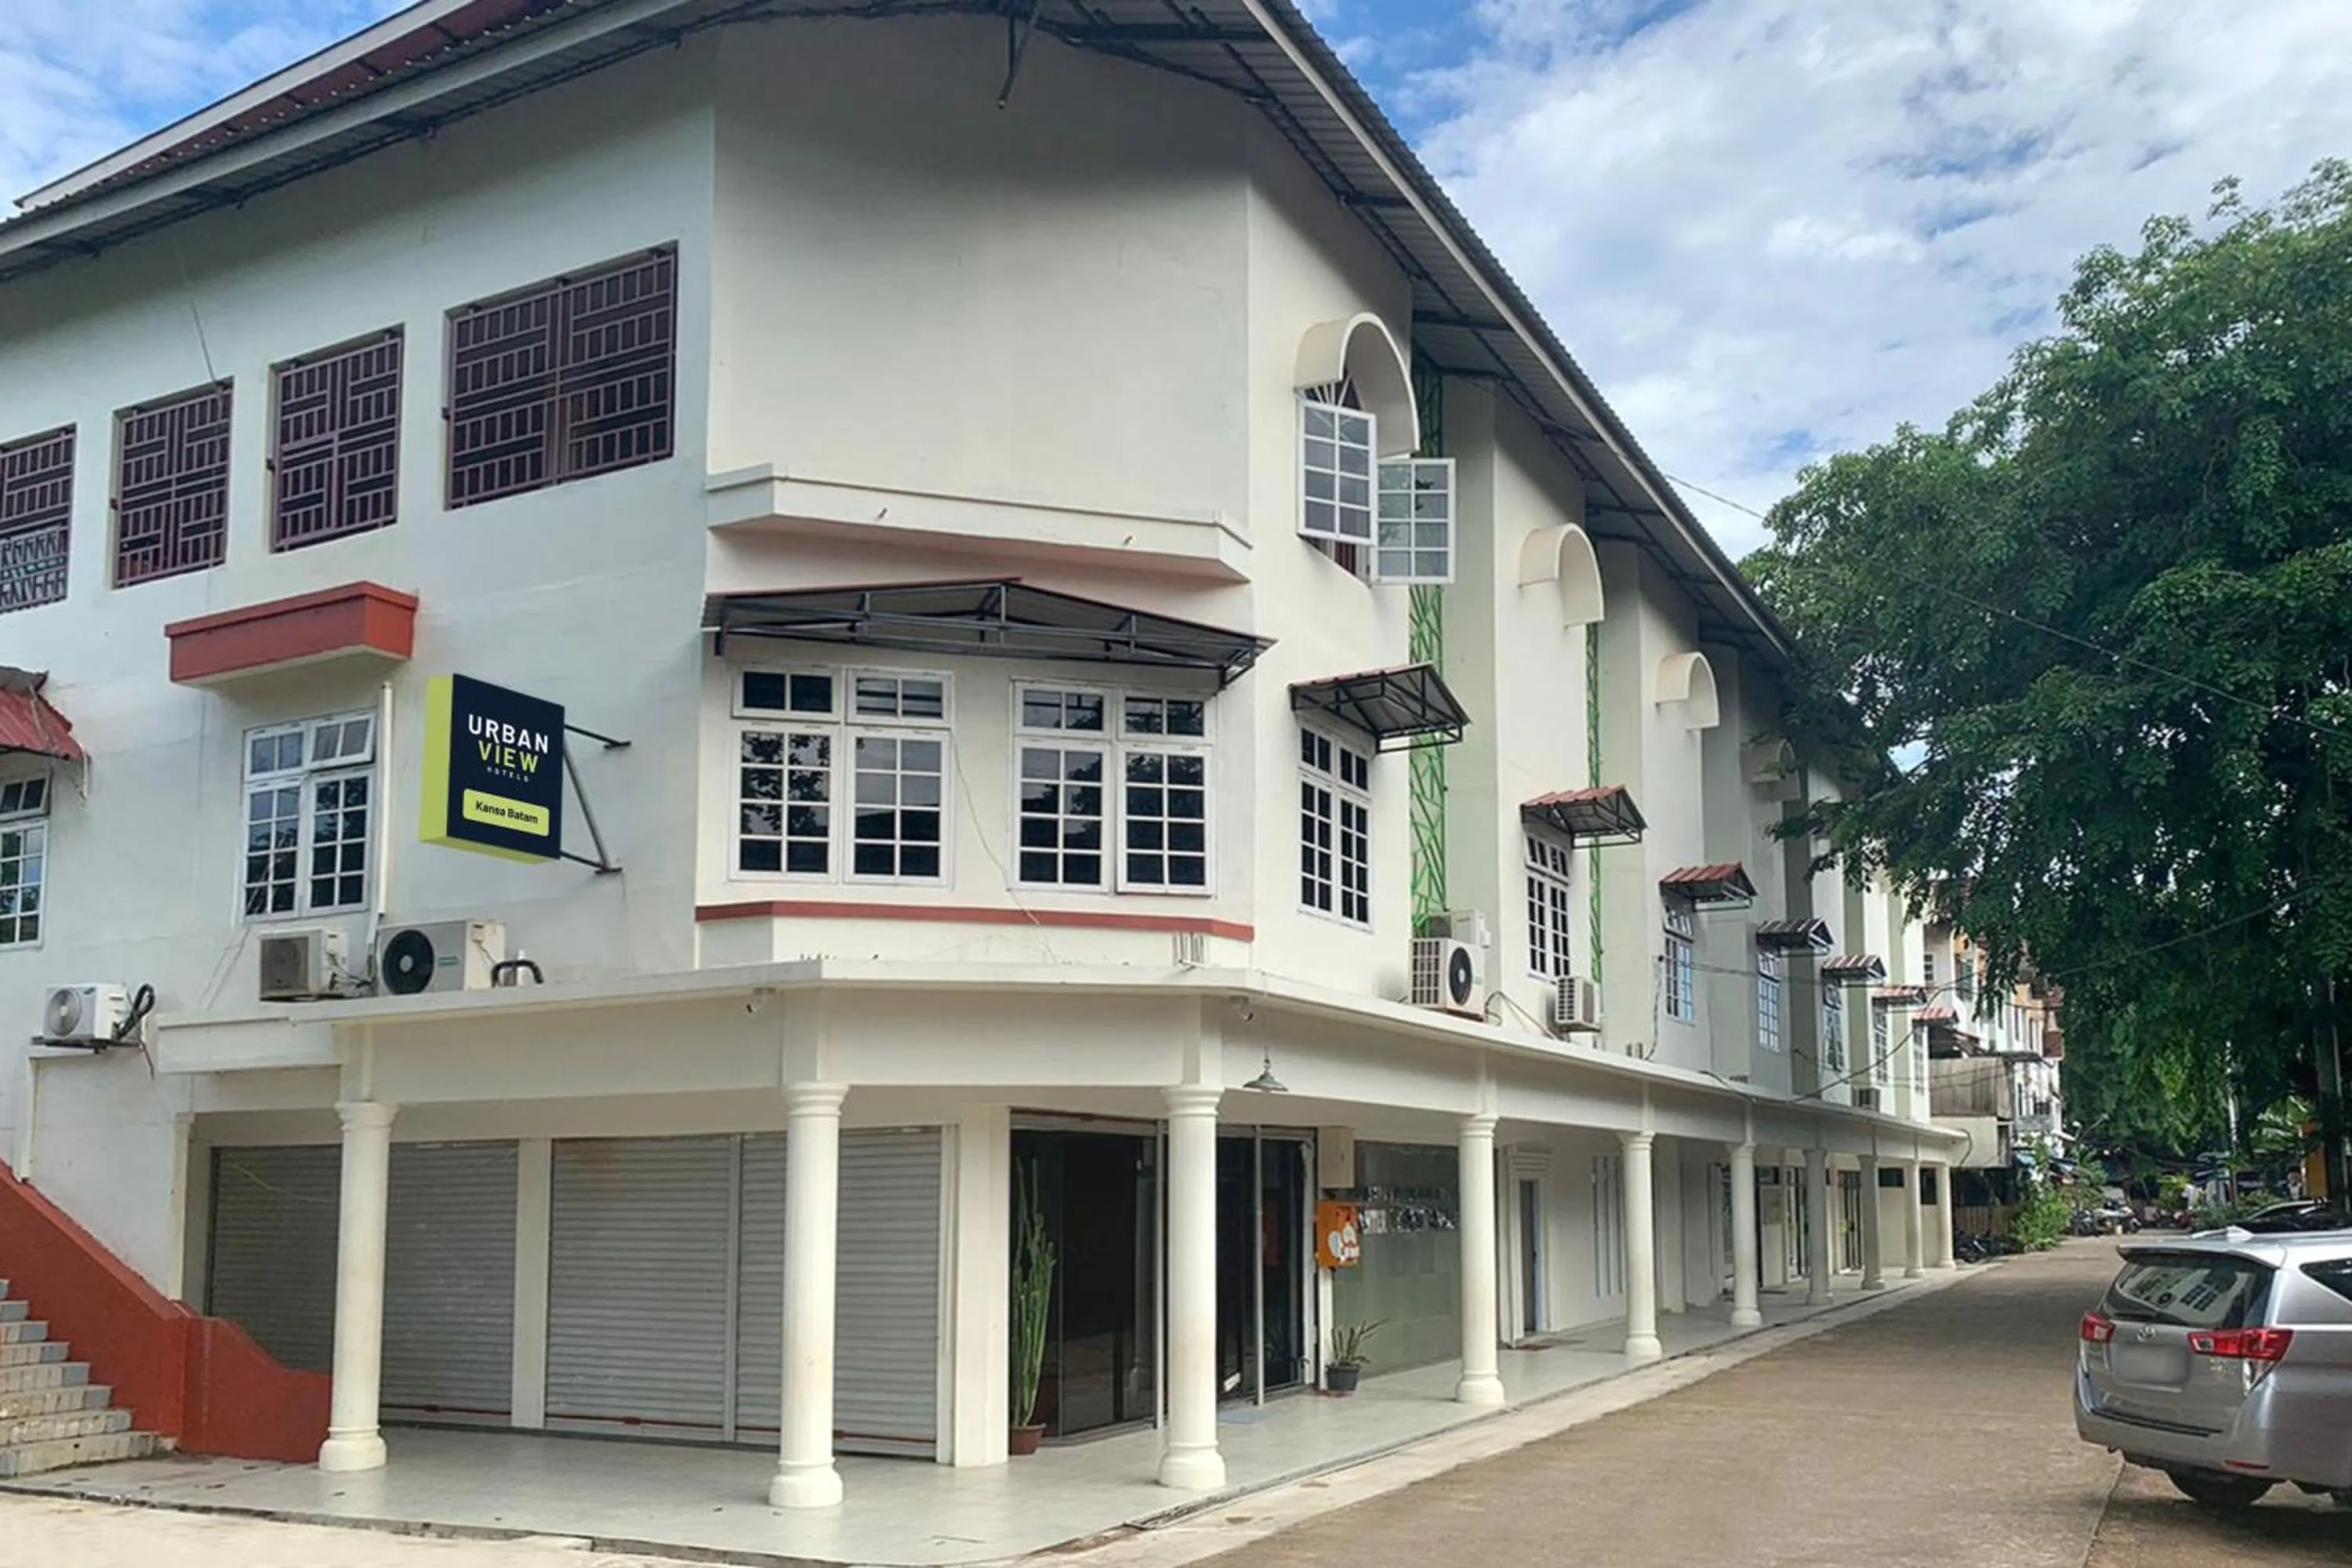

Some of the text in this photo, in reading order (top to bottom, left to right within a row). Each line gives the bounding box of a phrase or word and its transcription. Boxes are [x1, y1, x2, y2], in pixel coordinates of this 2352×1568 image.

[468, 713, 548, 753] URBAN
[478, 740, 539, 773] VIEW
[508, 808, 539, 824] Batam
